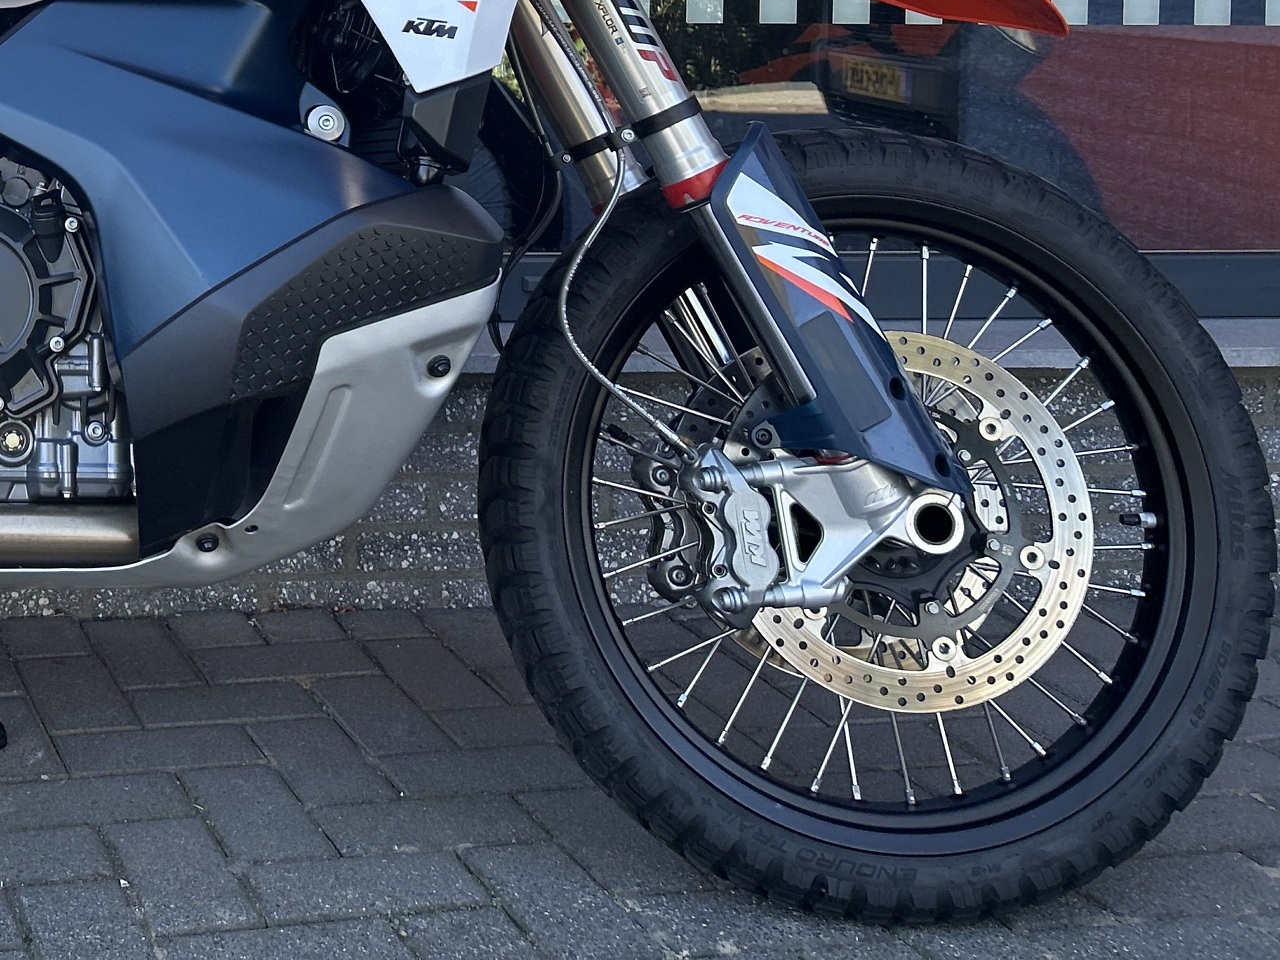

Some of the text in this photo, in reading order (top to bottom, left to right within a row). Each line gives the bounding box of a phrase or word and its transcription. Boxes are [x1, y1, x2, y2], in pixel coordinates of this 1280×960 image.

[401, 16, 458, 40] KTM
[594, 0, 618, 35] XPLOR
[737, 213, 830, 247] ADVENTURE
[739, 507, 769, 568] KTM
